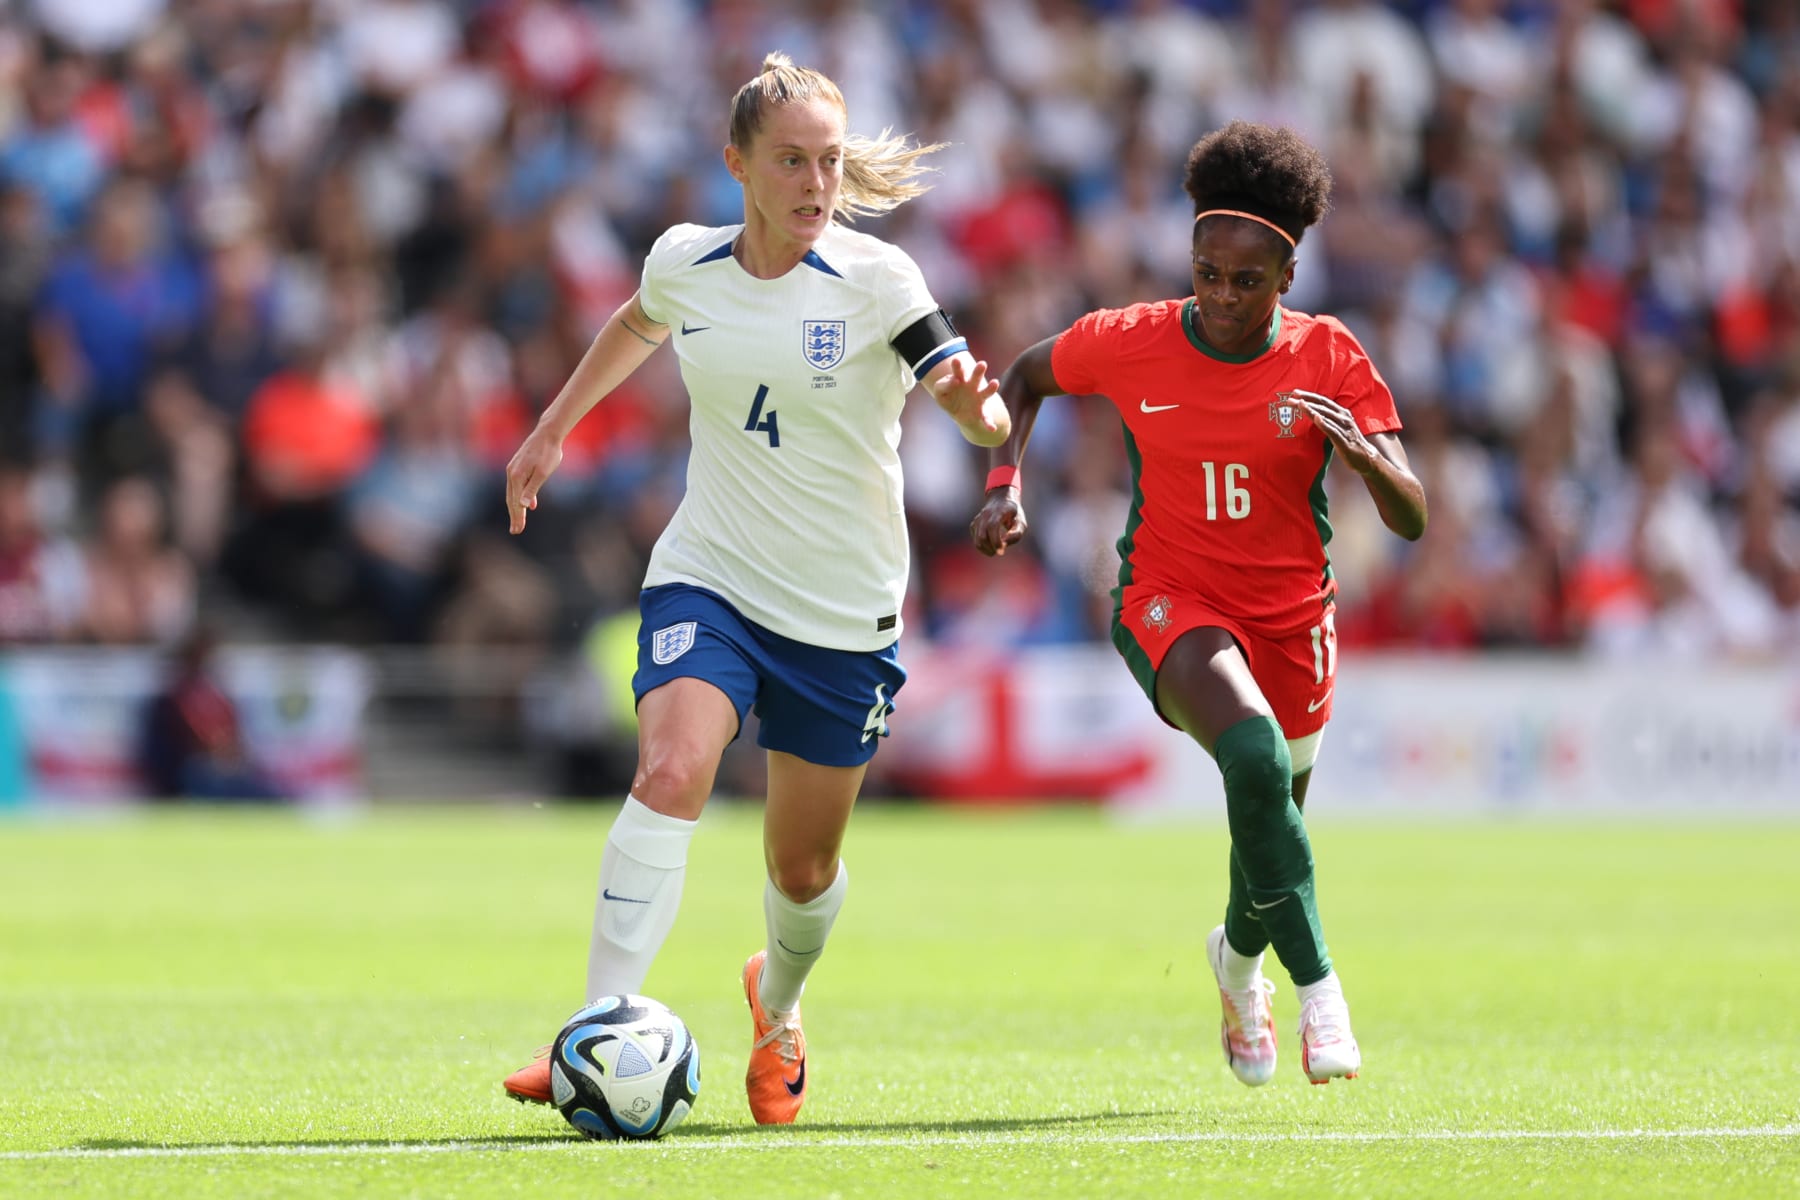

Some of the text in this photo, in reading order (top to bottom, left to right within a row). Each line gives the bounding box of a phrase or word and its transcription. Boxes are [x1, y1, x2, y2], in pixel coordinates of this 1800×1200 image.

[744, 383, 781, 448] 4
[1201, 461, 1251, 521] 16
[862, 682, 890, 736] 4
